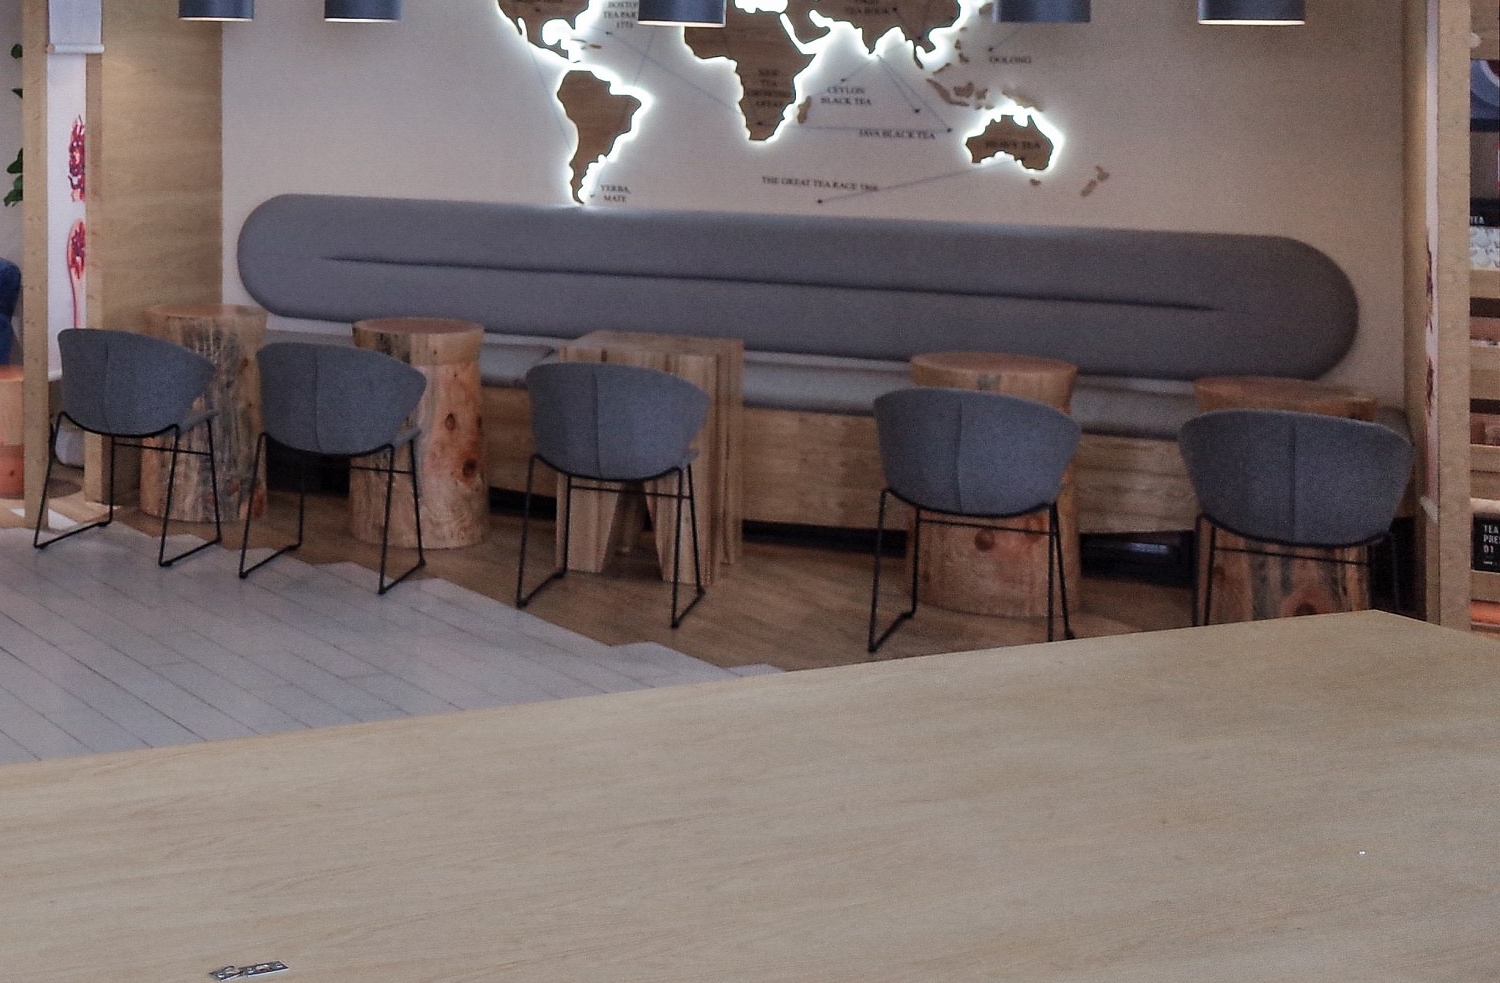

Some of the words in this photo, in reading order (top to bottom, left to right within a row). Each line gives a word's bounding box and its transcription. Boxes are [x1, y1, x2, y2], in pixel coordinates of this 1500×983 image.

[827, 86, 865, 95] CEYLON
[820, 97, 851, 106] BLACK
[854, 97, 872, 106] TEA
[762, 176, 780, 185] THE
[781, 177, 812, 187] GREAT
[603, 194, 627, 203] MATE
[1483, 524, 1499, 534] TEA
[1483, 534, 1500, 545] PRE
